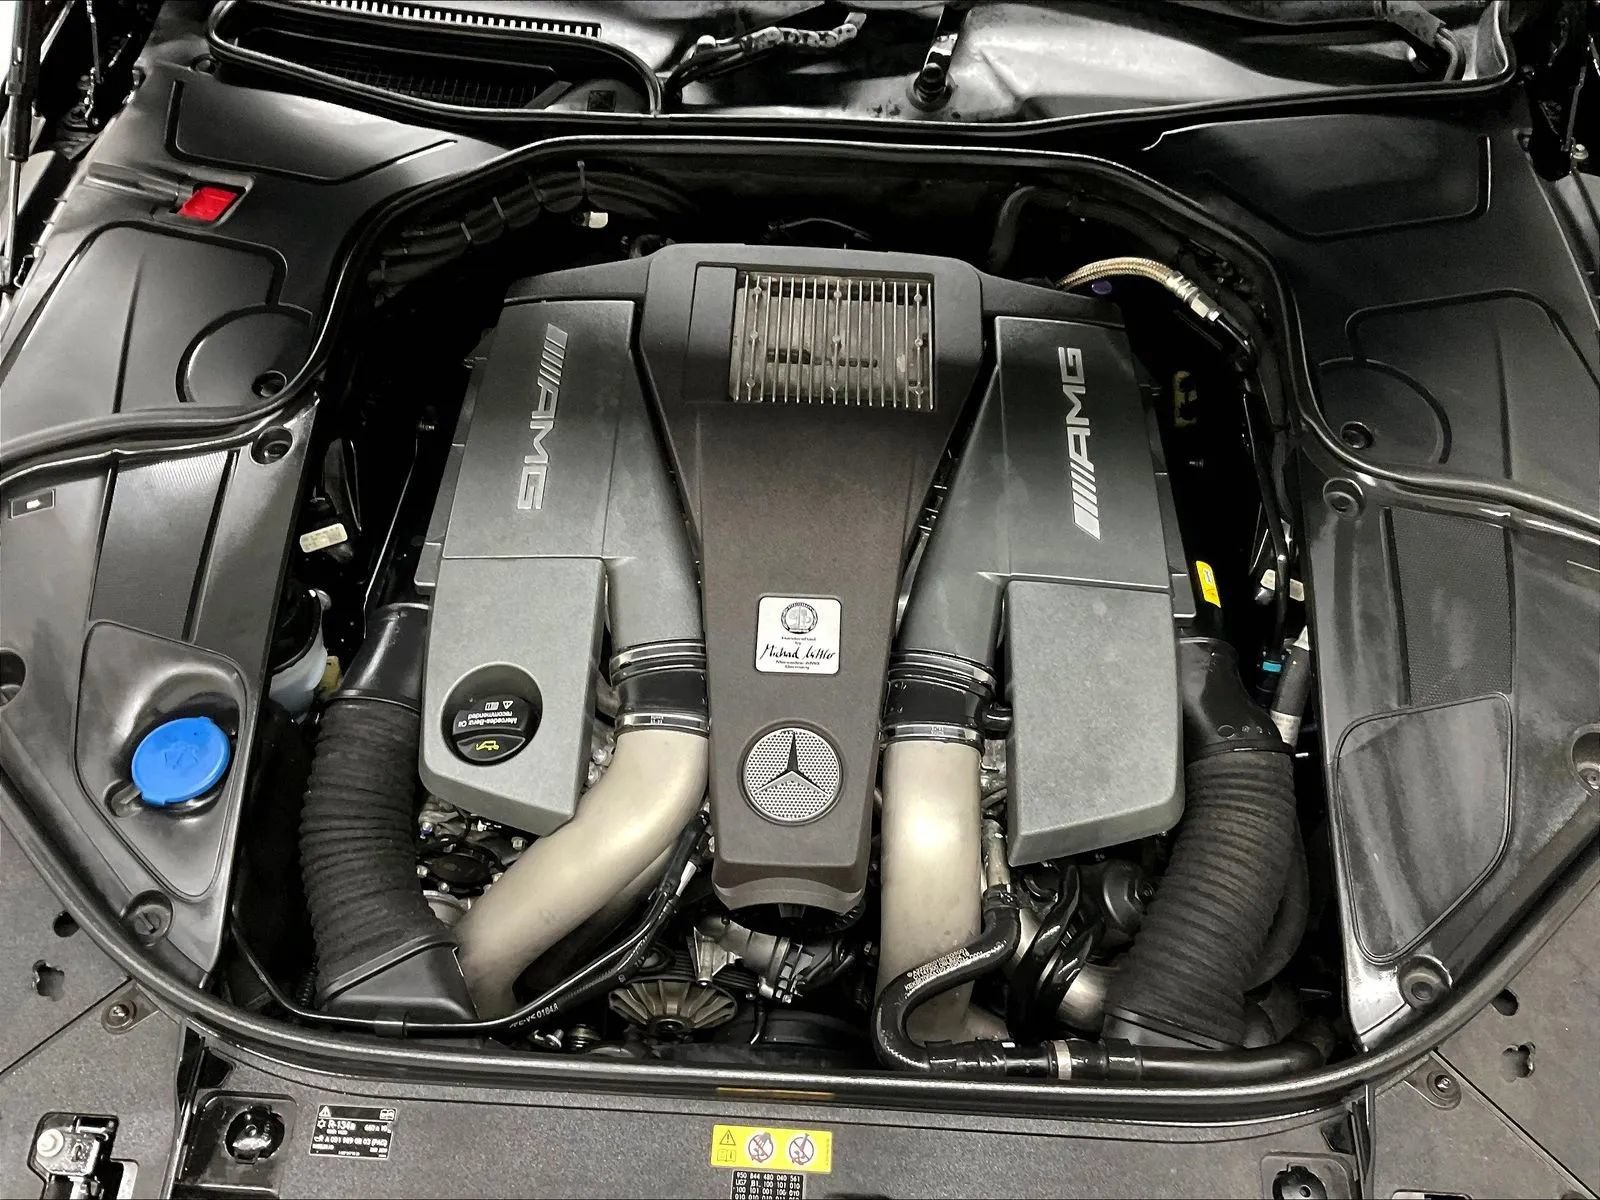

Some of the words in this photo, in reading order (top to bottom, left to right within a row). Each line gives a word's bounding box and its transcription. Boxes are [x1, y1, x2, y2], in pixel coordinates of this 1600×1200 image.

[1058, 346, 1095, 473] AMG
[517, 376, 559, 509] AMG
[467, 711, 513, 720] recommended
[458, 720, 467, 728] Oil
[468, 717, 518, 726] Mercedes-Benz
